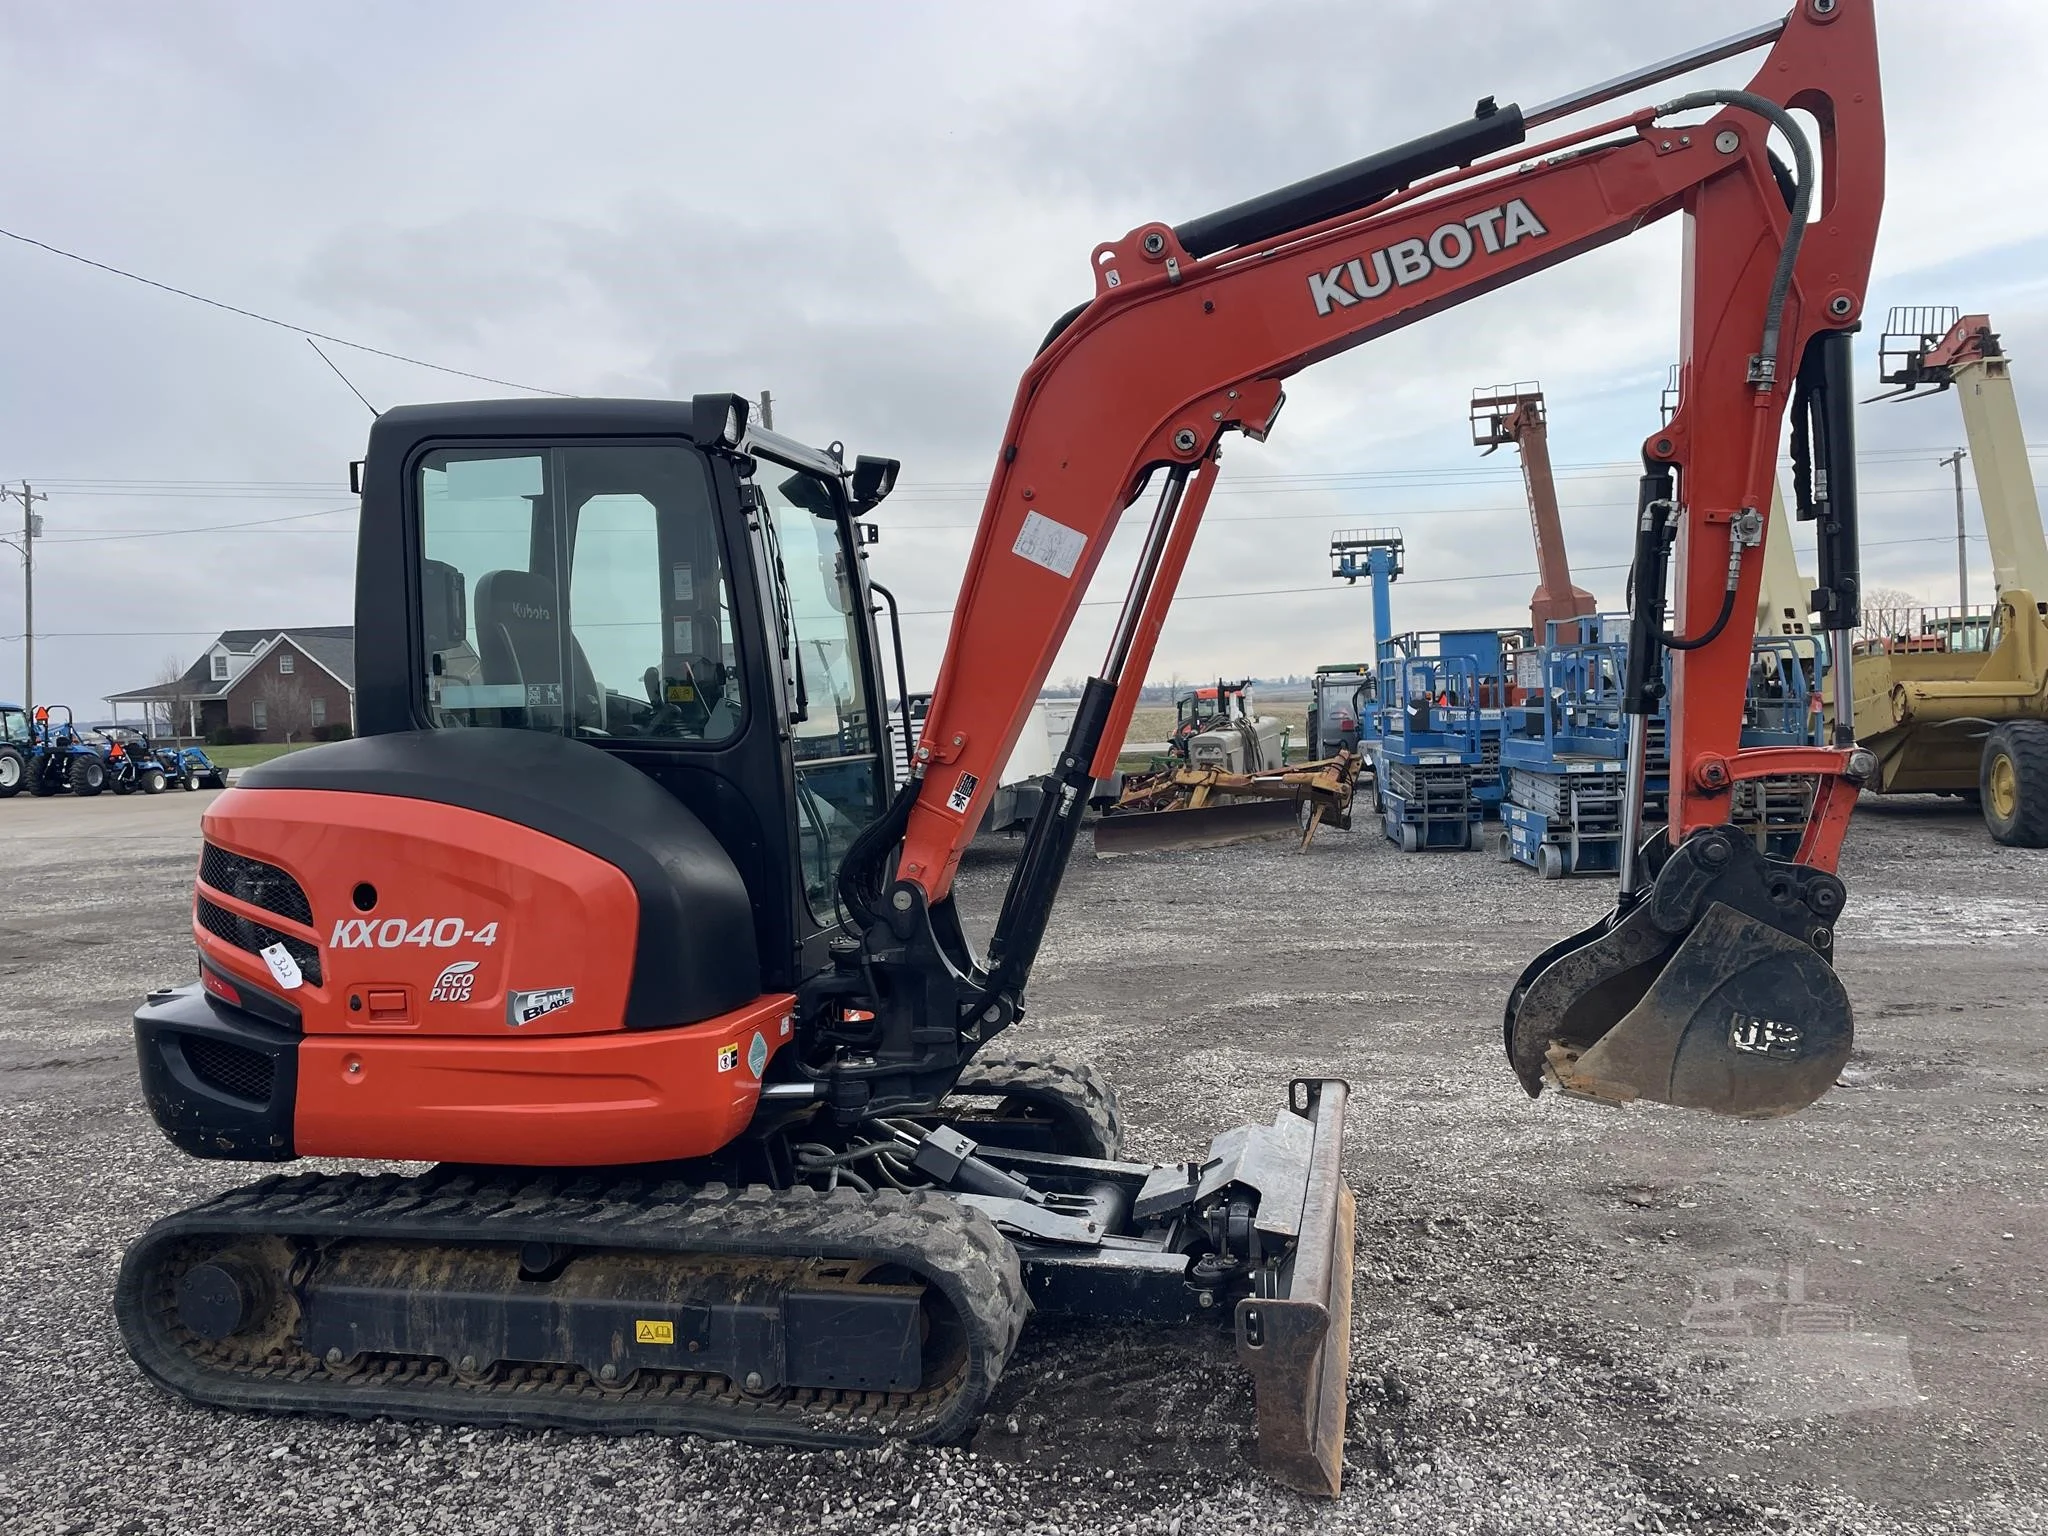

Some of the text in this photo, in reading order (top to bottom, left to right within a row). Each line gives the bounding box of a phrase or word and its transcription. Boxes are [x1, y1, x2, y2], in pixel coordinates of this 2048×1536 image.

[1307, 198, 1548, 316] KUBOTA
[329, 917, 499, 949] KX040-4
[441, 973, 475, 988] eco
[429, 987, 473, 1002] PLUS
[523, 997, 571, 1022] BLADE
